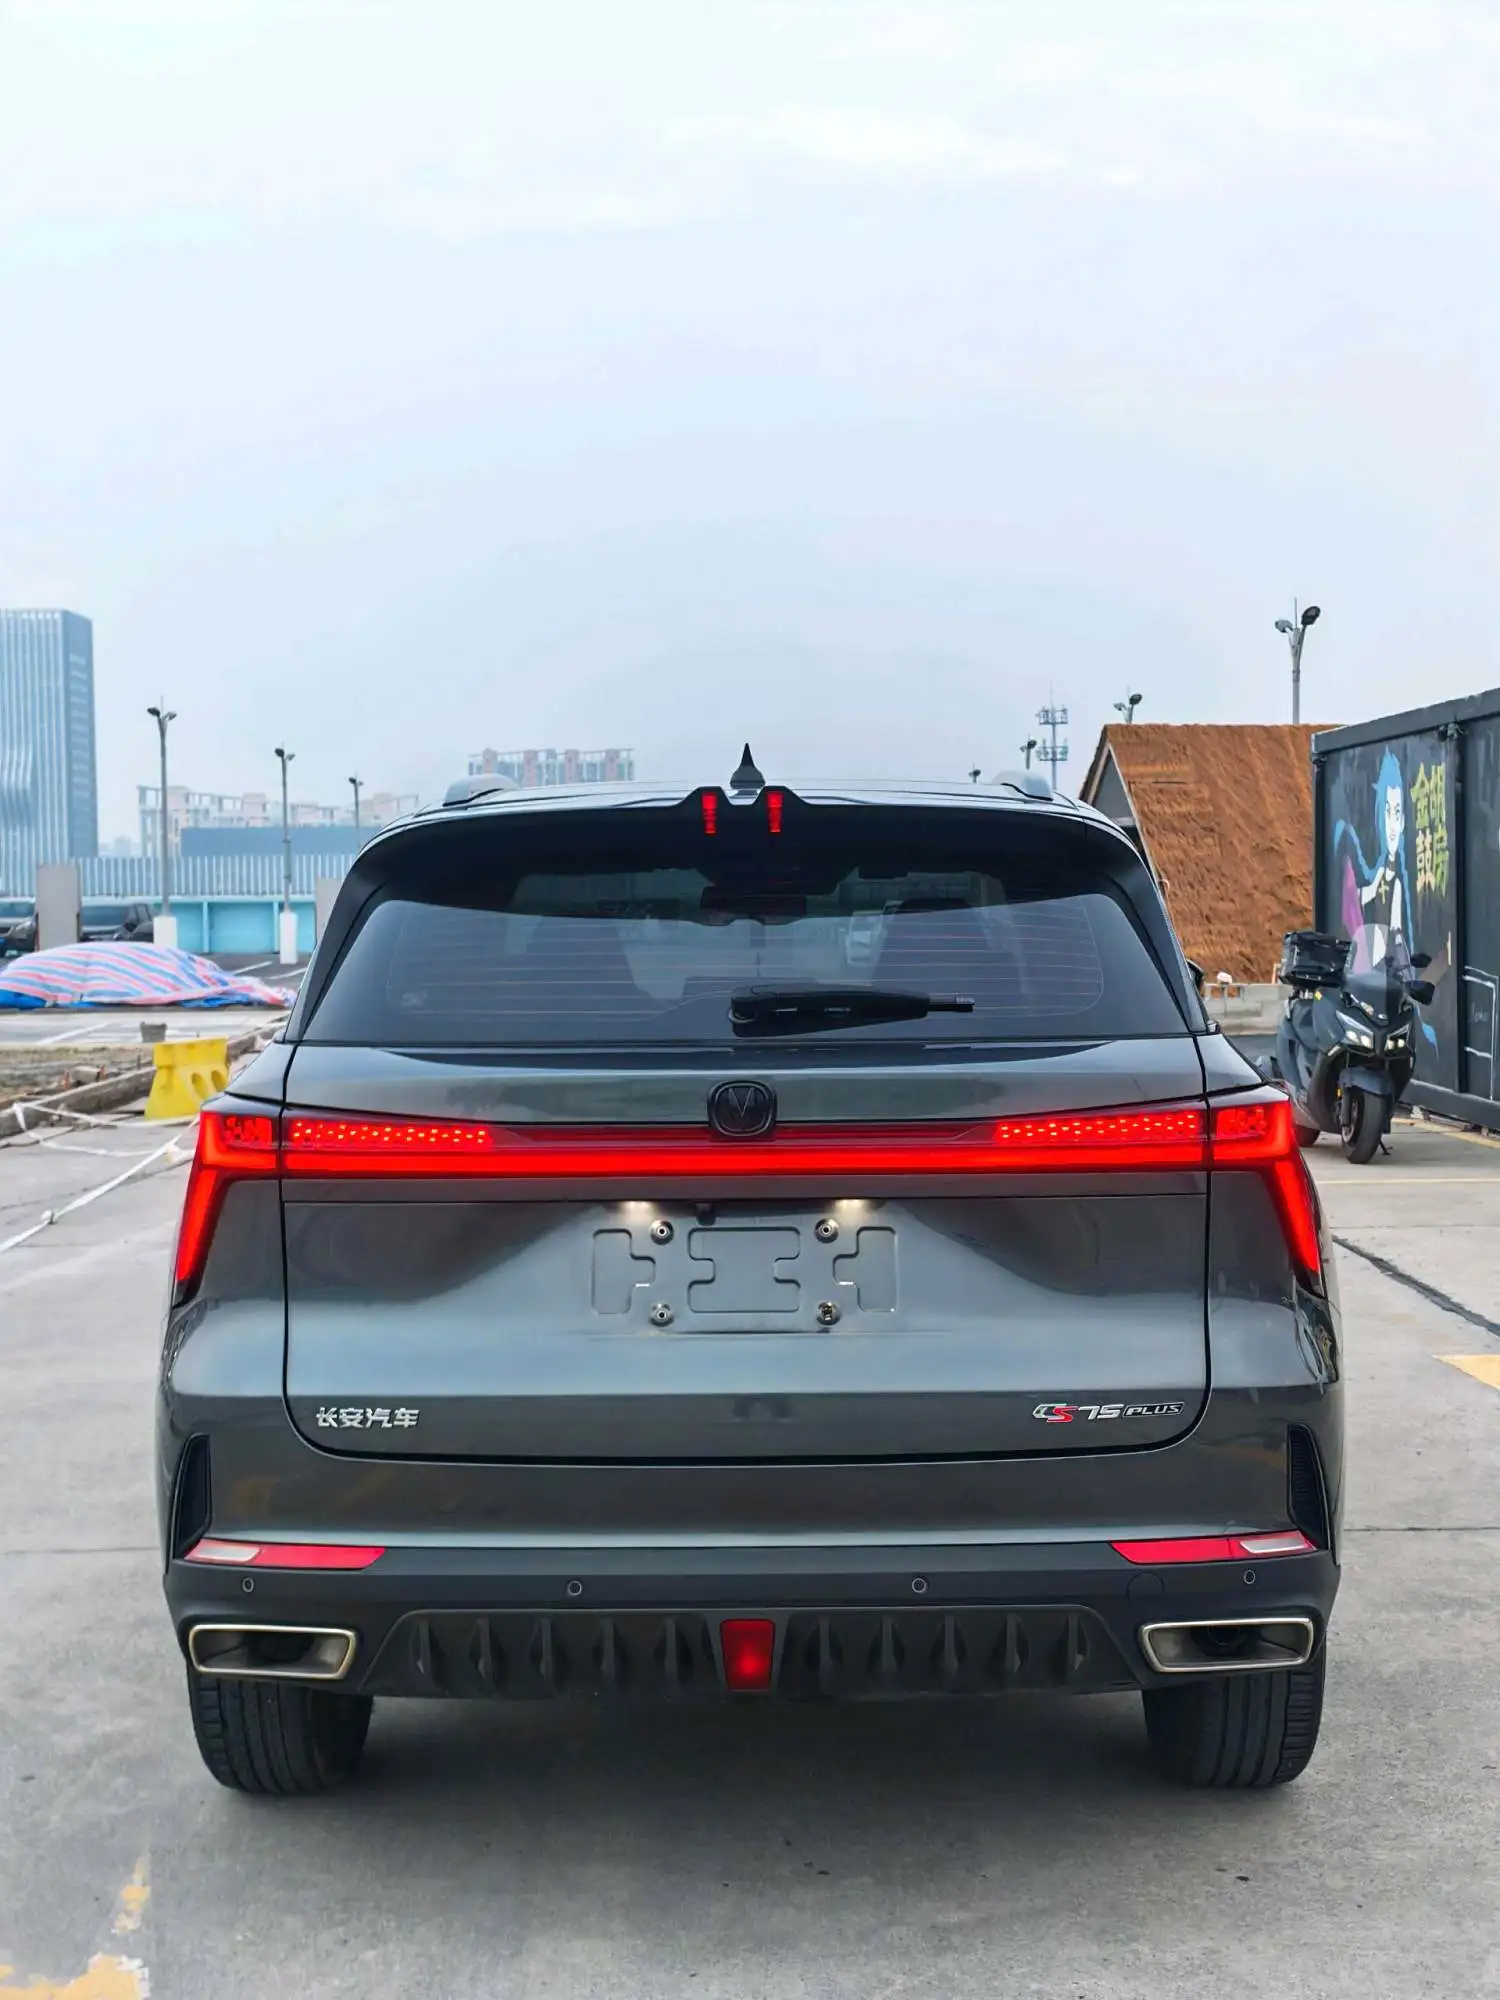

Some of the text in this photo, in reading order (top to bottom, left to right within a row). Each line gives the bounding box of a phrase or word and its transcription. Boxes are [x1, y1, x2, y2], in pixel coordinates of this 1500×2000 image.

[315, 1407, 420, 1428] 长安汽车
[1125, 1404, 1181, 1417] PLUS
